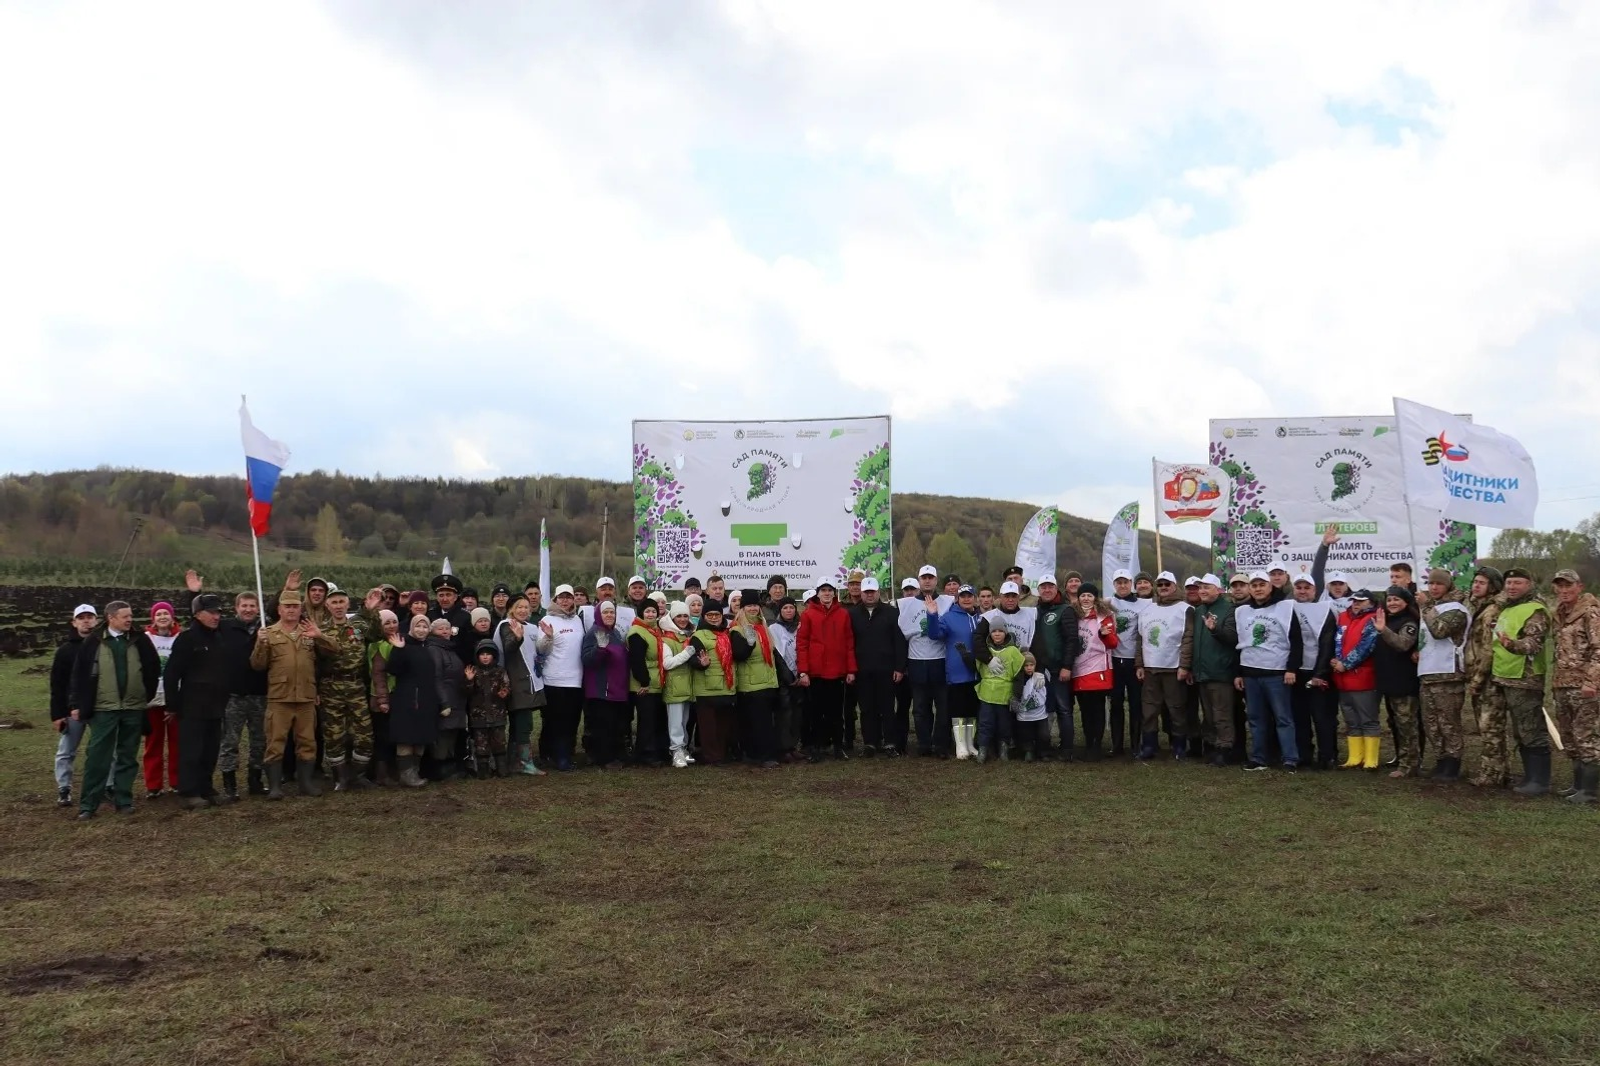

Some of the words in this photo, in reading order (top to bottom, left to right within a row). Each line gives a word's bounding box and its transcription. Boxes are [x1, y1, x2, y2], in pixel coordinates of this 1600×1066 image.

[732, 452, 750, 469] САД
[750, 448, 788, 469] ПАМЯТИ
[1315, 452, 1333, 469] САД
[1333, 448, 1373, 469] ПАМЯТИ
[1339, 522, 1377, 533] ГЕРОЕВ
[1331, 542, 1373, 551] ПАМЯТЬ
[1291, 552, 1359, 563] ЗАЩНИКАХ
[1361, 552, 1414, 561] ОТЕЧЕСТВА
[714, 560, 767, 568] ЗАЩИТНИКЕ
[768, 559, 818, 567] ОТЕЧЕСТВА
